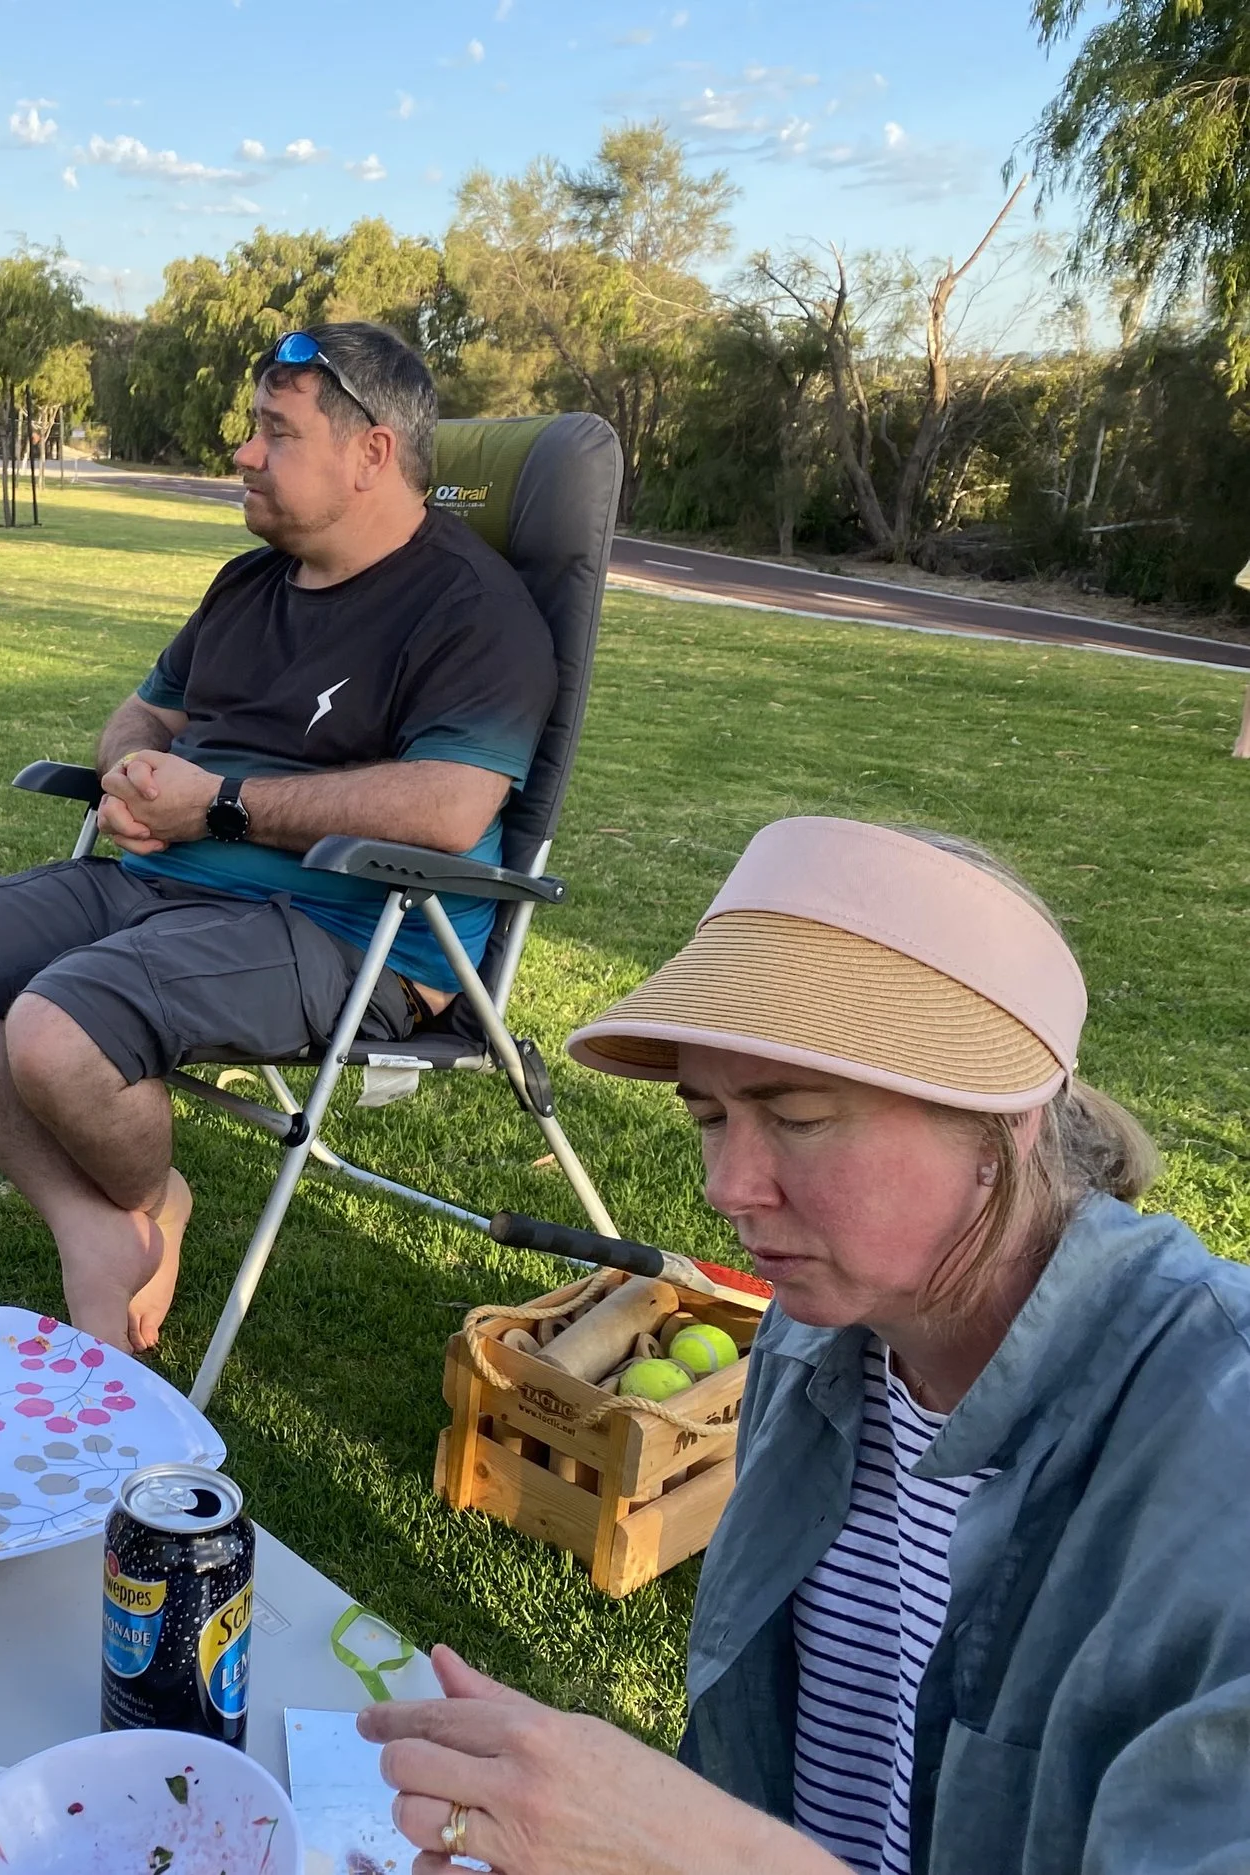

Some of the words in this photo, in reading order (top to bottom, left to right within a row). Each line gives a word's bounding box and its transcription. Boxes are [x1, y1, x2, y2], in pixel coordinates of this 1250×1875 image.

[436, 485, 488, 500] OZtrail
[525, 1386, 573, 1418] TACTIC
[518, 1404, 576, 1437] www.tactic.net
[106, 1579, 151, 1606] weppes
[218, 1590, 252, 1645] Sch
